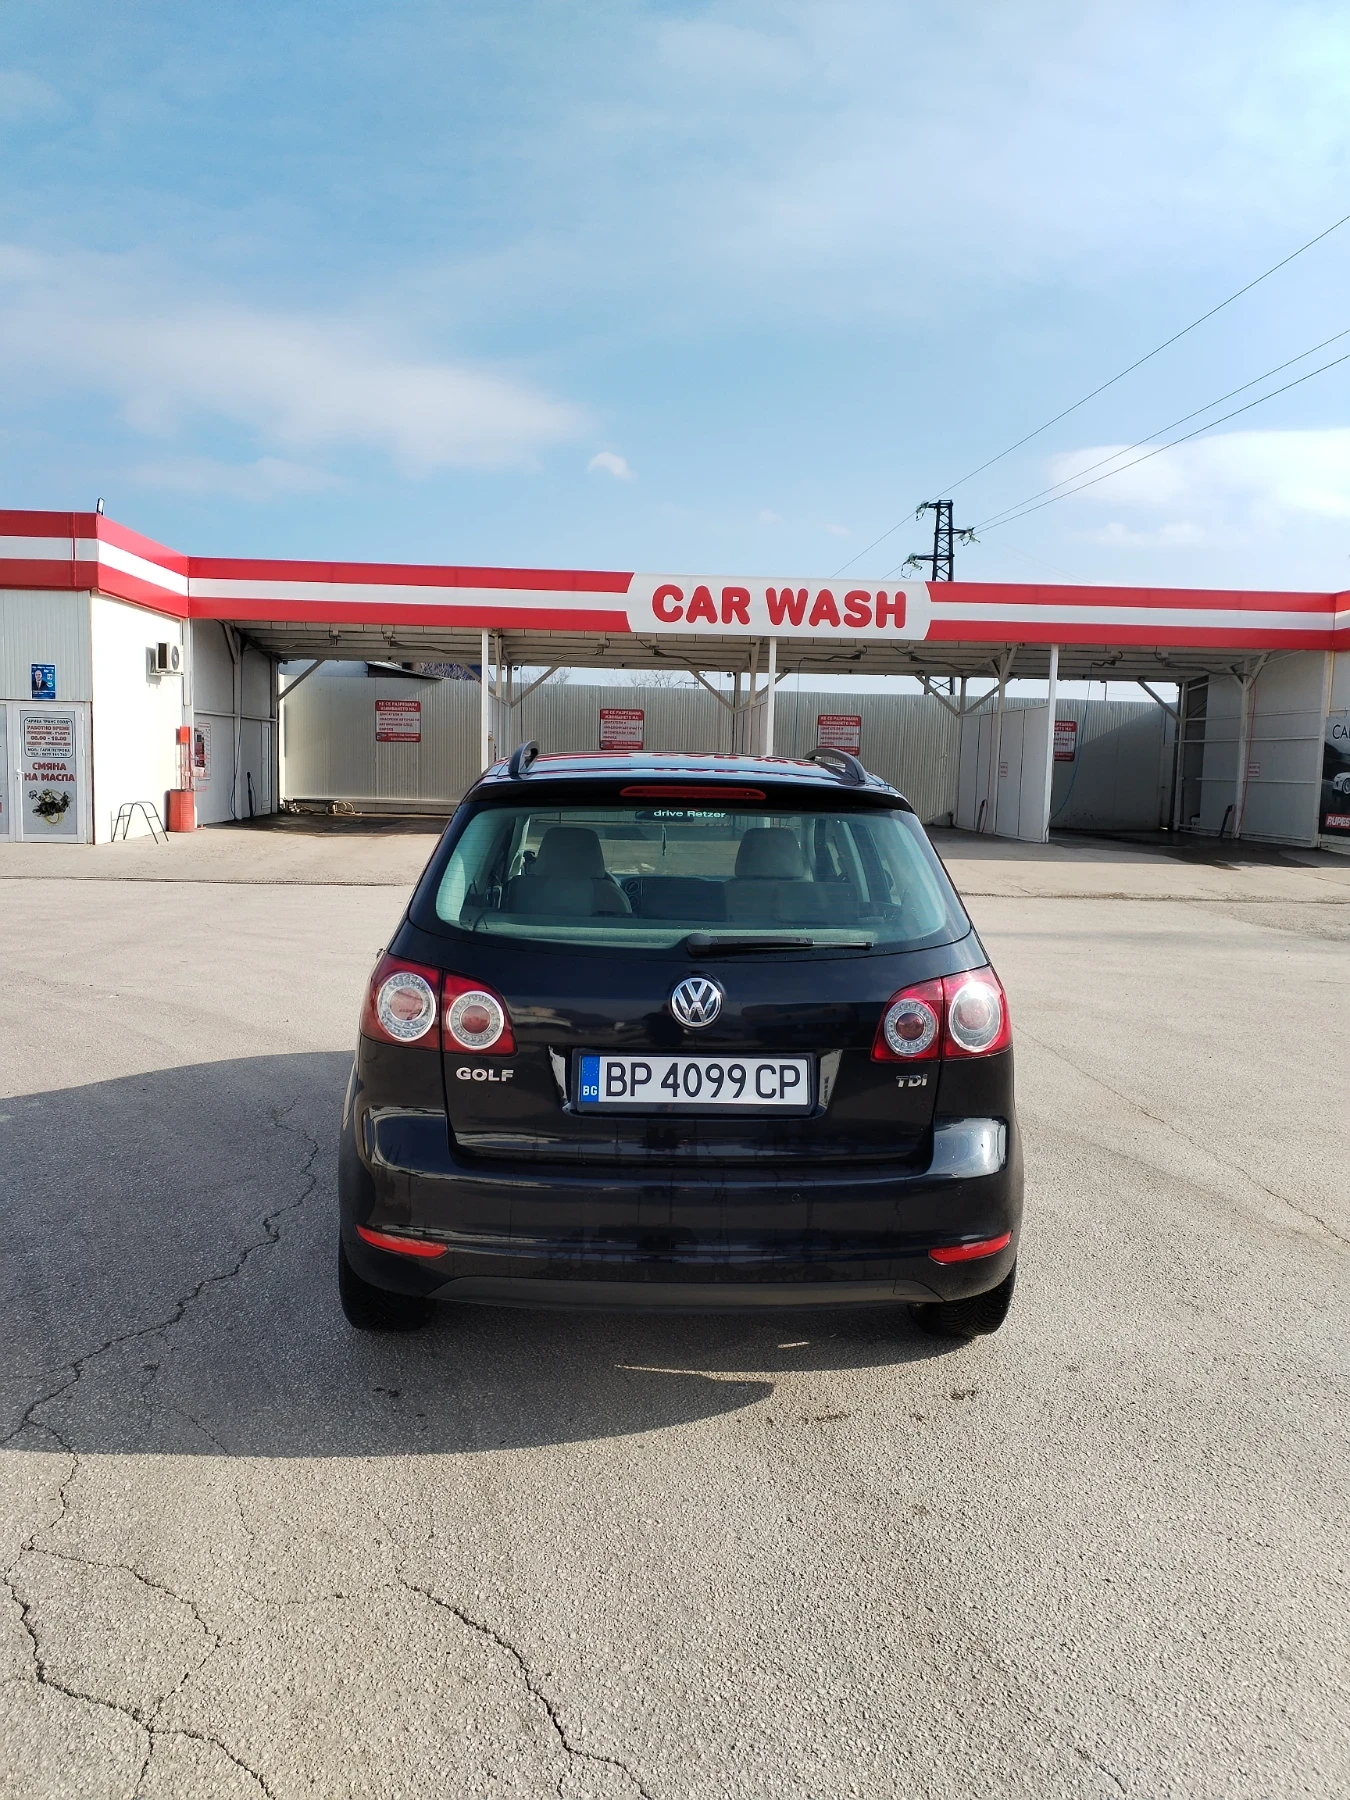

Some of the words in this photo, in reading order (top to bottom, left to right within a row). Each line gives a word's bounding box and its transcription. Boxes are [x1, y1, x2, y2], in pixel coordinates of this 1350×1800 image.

[651, 584, 751, 625] CAR
[765, 587, 907, 629] WASH
[1332, 724, 1350, 740] CA
[32, 763, 66, 771] СМЯНА
[456, 1066, 514, 1082] GOLF
[606, 1062, 652, 1097] BP
[660, 1062, 747, 1099] 4099
[755, 1064, 801, 1099] CP
[582, 1085, 598, 1096] BG
